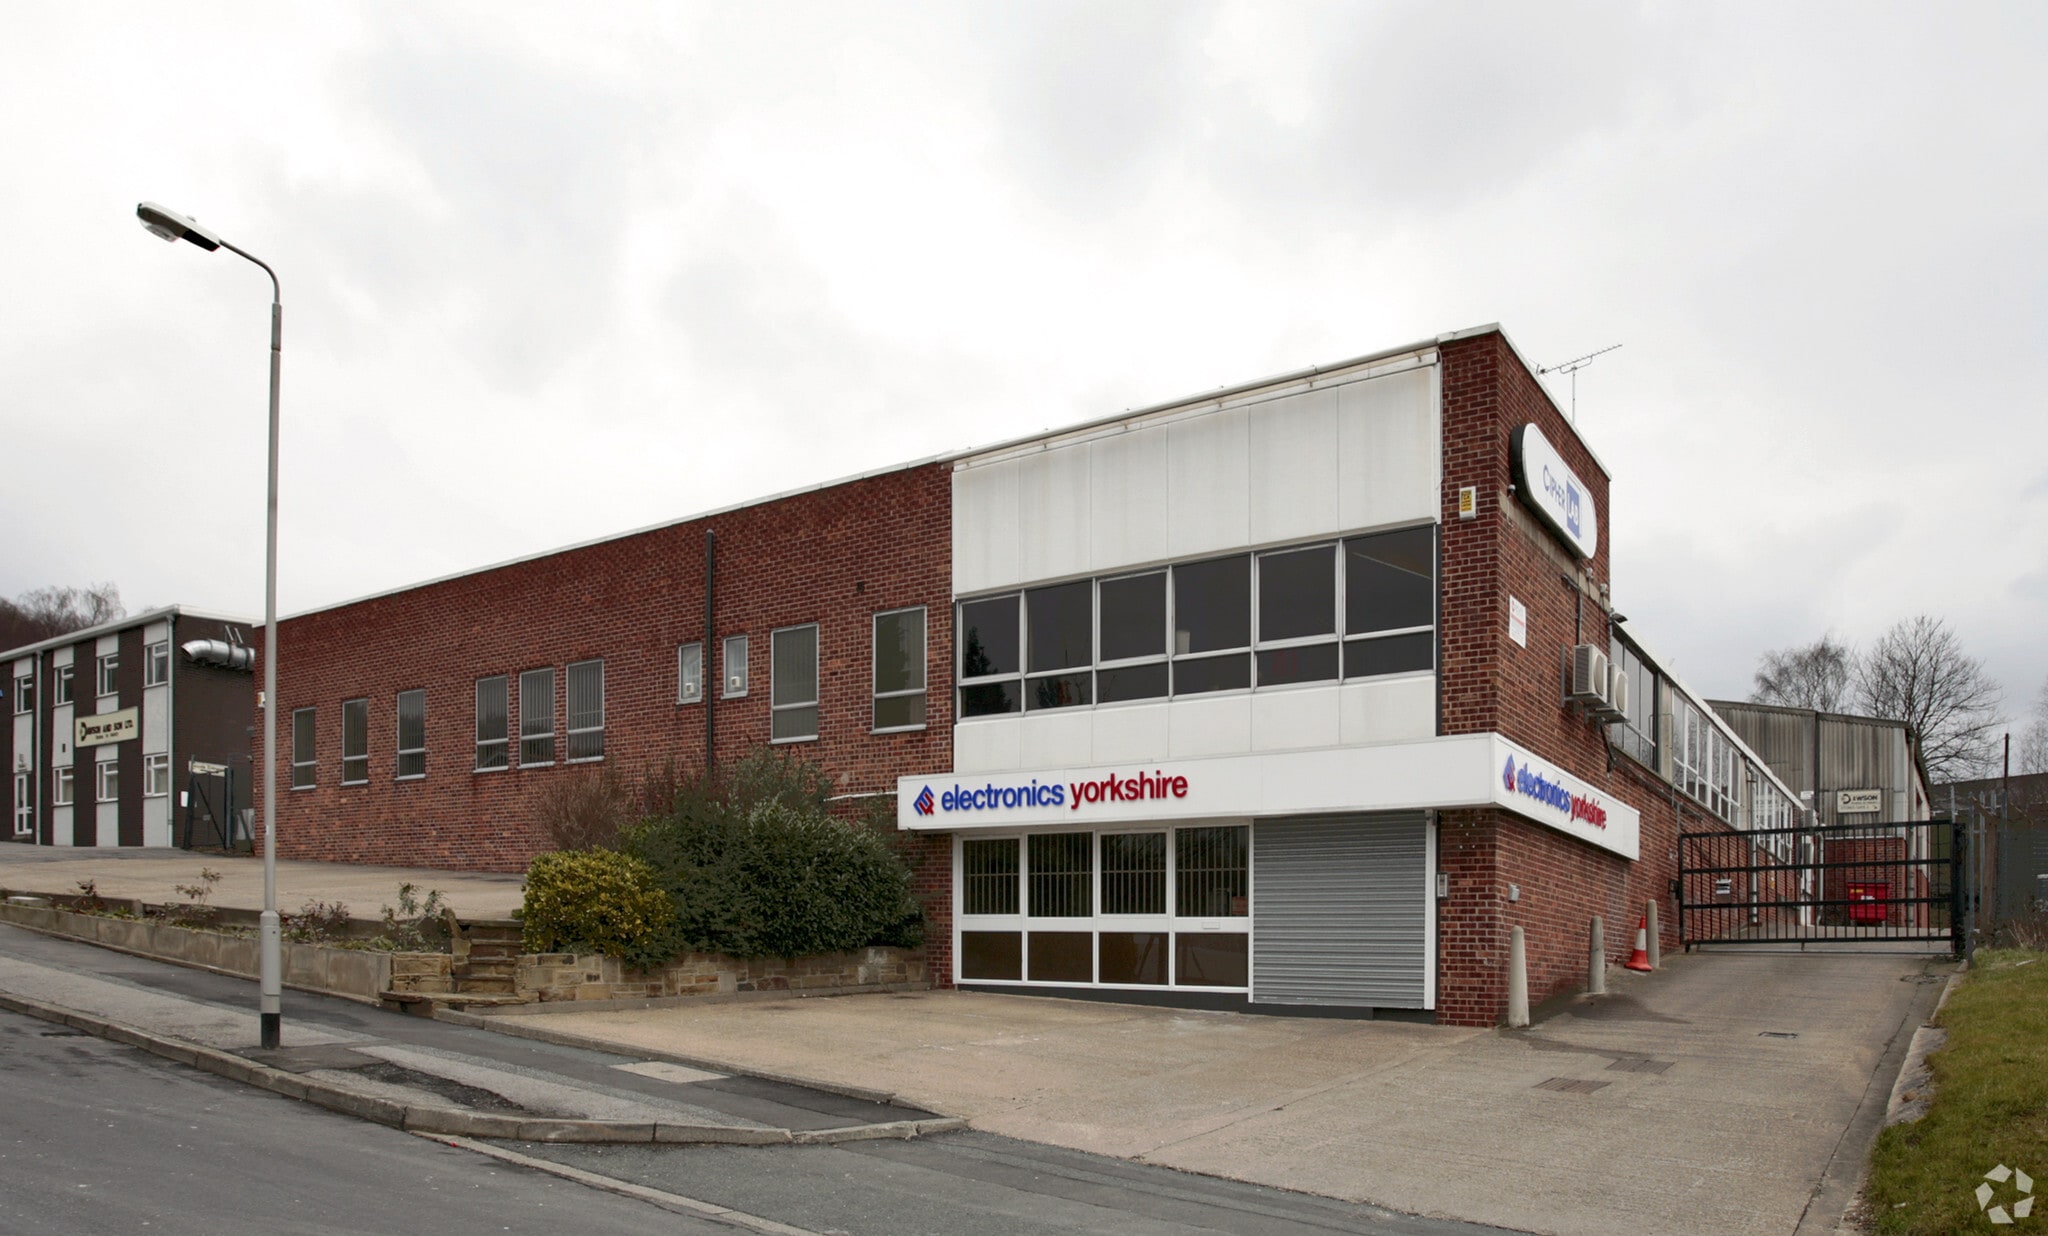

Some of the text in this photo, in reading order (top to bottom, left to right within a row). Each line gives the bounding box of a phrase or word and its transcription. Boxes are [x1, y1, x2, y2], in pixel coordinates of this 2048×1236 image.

[113, 721, 123, 731] SON
[941, 769, 1189, 812] electronics yorkshire
[1517, 761, 1607, 830] electronics yorkshire
